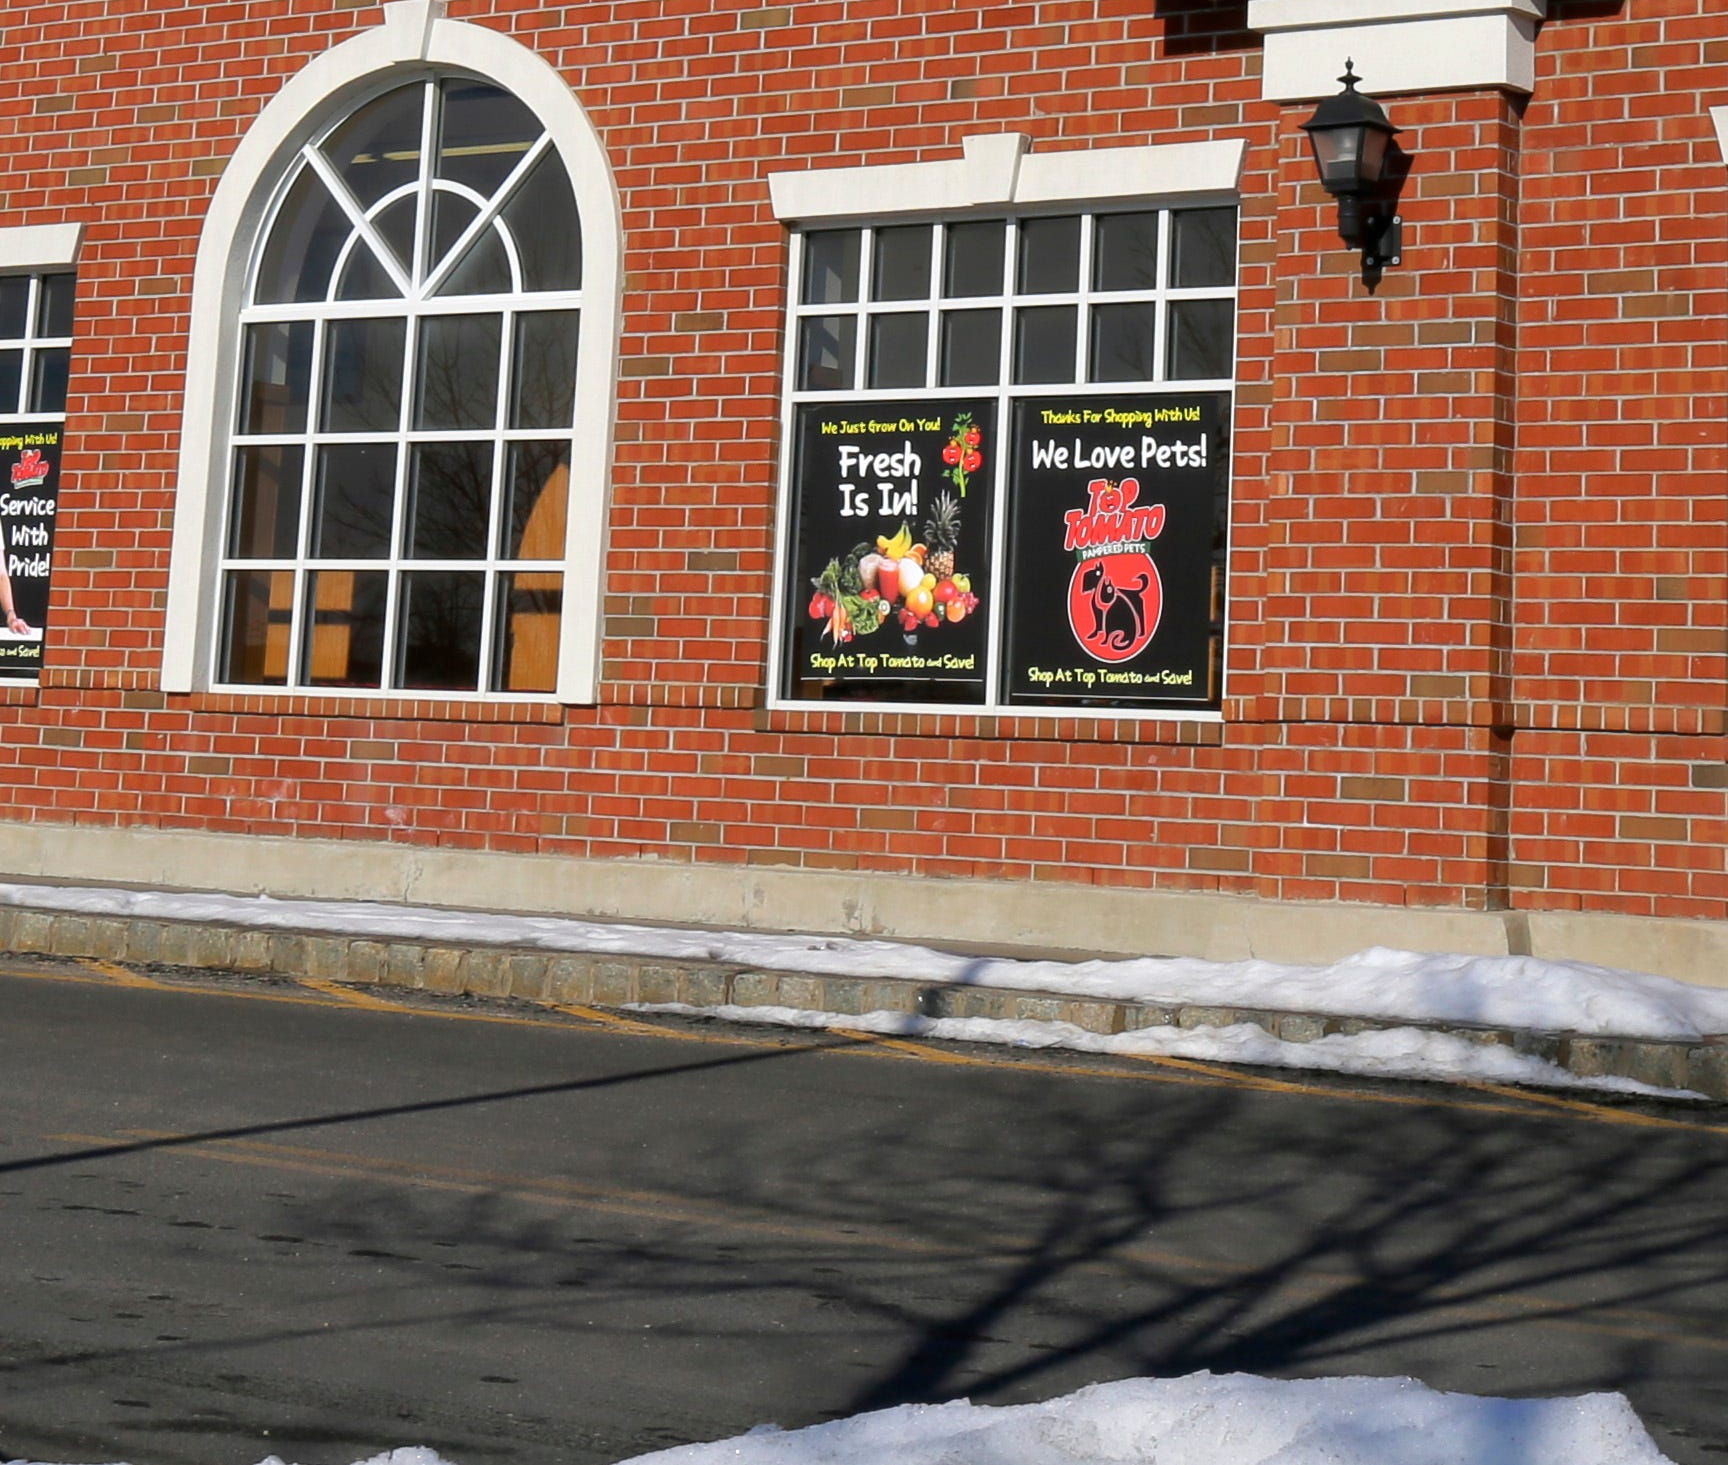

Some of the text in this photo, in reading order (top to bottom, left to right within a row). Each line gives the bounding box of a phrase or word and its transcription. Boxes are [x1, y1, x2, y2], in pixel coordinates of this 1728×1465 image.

[822, 417, 940, 434] We Just Grow On You!
[1041, 406, 1200, 428] Thanks For Shopping With Us!
[25, 433, 44, 445] With
[838, 440, 921, 478] Fresh
[1032, 433, 1207, 469] We Love Pets!
[0, 493, 55, 516] Service
[838, 478, 918, 516] Is In!
[12, 522, 48, 546] With
[1064, 504, 1165, 551] TOMATO
[1082, 543, 1146, 560] PAMPERED PETS
[8, 553, 50, 577] Pride!
[810, 653, 974, 674] Shop At Top Tomato and Save!
[1028, 667, 1193, 688] Shop At Top Tomato and Save!
